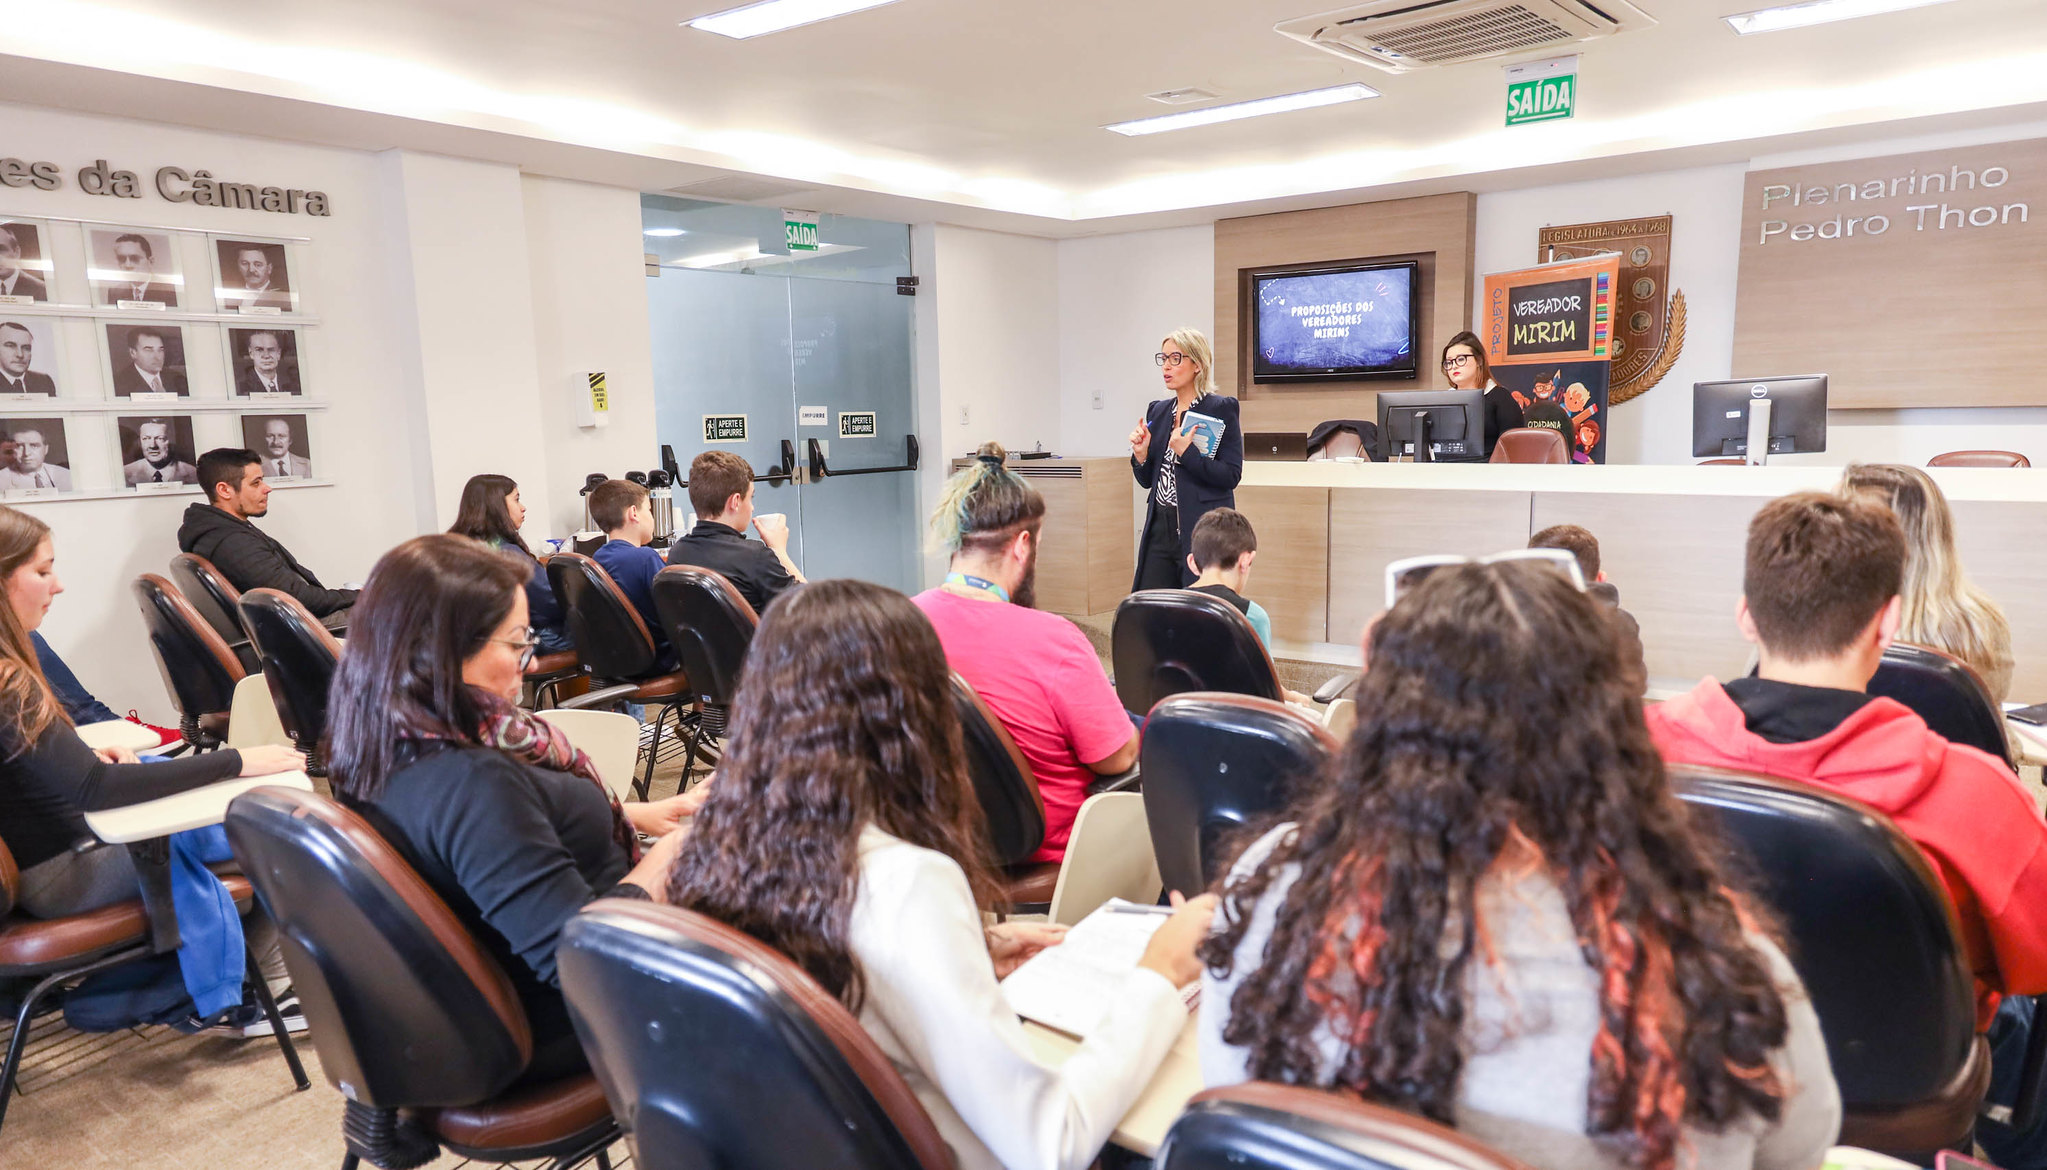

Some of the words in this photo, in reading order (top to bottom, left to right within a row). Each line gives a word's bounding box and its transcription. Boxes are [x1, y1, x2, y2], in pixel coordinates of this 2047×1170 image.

[1507, 79, 1570, 117] SAÍDA
[78, 160, 142, 198] da
[155, 166, 331, 217] Câmara
[1762, 165, 2009, 210] Plenarinho
[1542, 227, 1608, 241] LEGISLATURA
[1617, 224, 1638, 236] 1964
[1646, 221, 1667, 233] 1968
[1759, 214, 1890, 245] Pedro
[1905, 202, 2029, 231] Thon
[785, 222, 819, 246] SAÍDA
[1291, 302, 1352, 317] PROPOSIÇÕES
[1355, 301, 1374, 312] DOS
[1513, 295, 1581, 316] VEREADOR
[1302, 314, 1362, 327] VEREADORES
[1491, 288, 1503, 355] PROJETO
[1314, 327, 1350, 339] MIRINS
[1513, 320, 1576, 345] MIRIM
[718, 419, 738, 429] APERTE
[739, 419, 743, 428] E
[851, 424, 873, 433] EMPURRE
[852, 416, 868, 425] APERTE
[868, 416, 872, 424] E
[718, 428, 744, 438] EMPURRE
